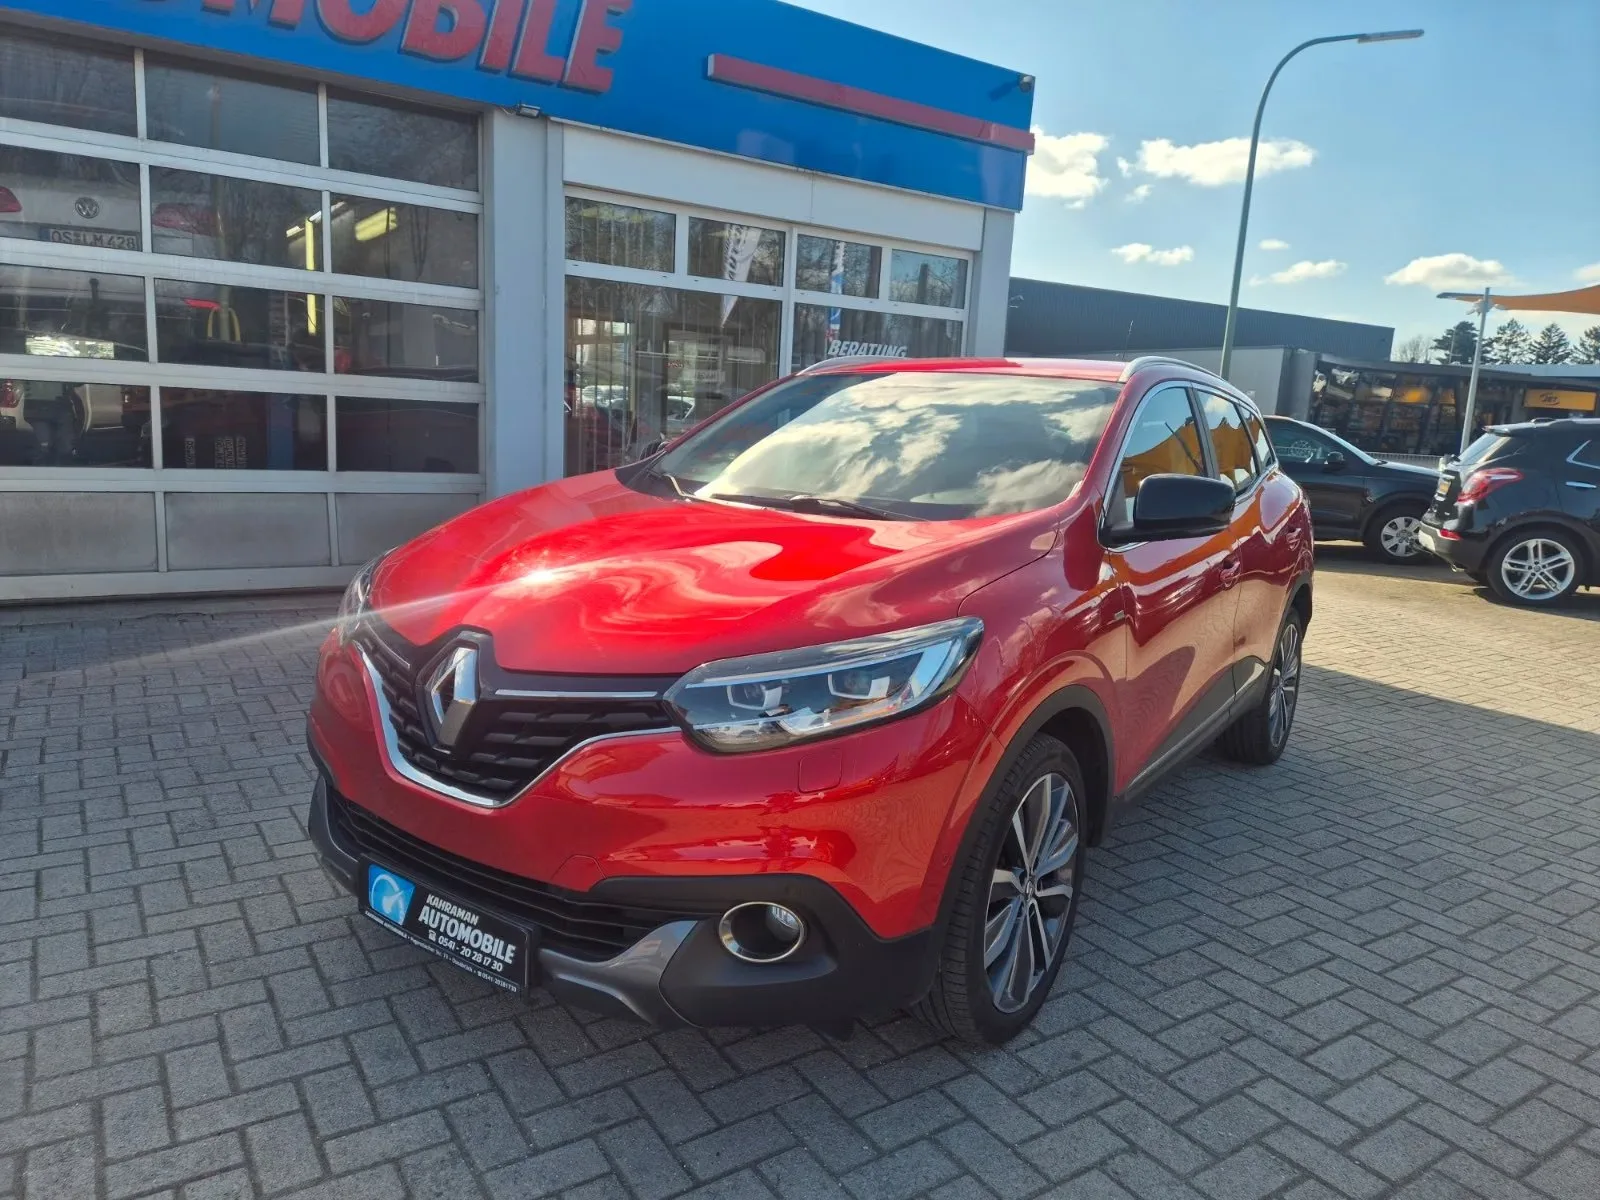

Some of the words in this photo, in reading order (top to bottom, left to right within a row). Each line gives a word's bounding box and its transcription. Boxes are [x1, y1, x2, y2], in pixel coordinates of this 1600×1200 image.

[827, 339, 908, 358] BERATUNG
[426, 894, 479, 926] KAHRAMAN
[418, 906, 517, 965] AUTOMOBILE
[438, 935, 456, 951] 0541
[460, 946, 472, 958] 20
[472, 951, 483, 964] 28
[483, 957, 492, 967] 17
[492, 961, 503, 972] 30
